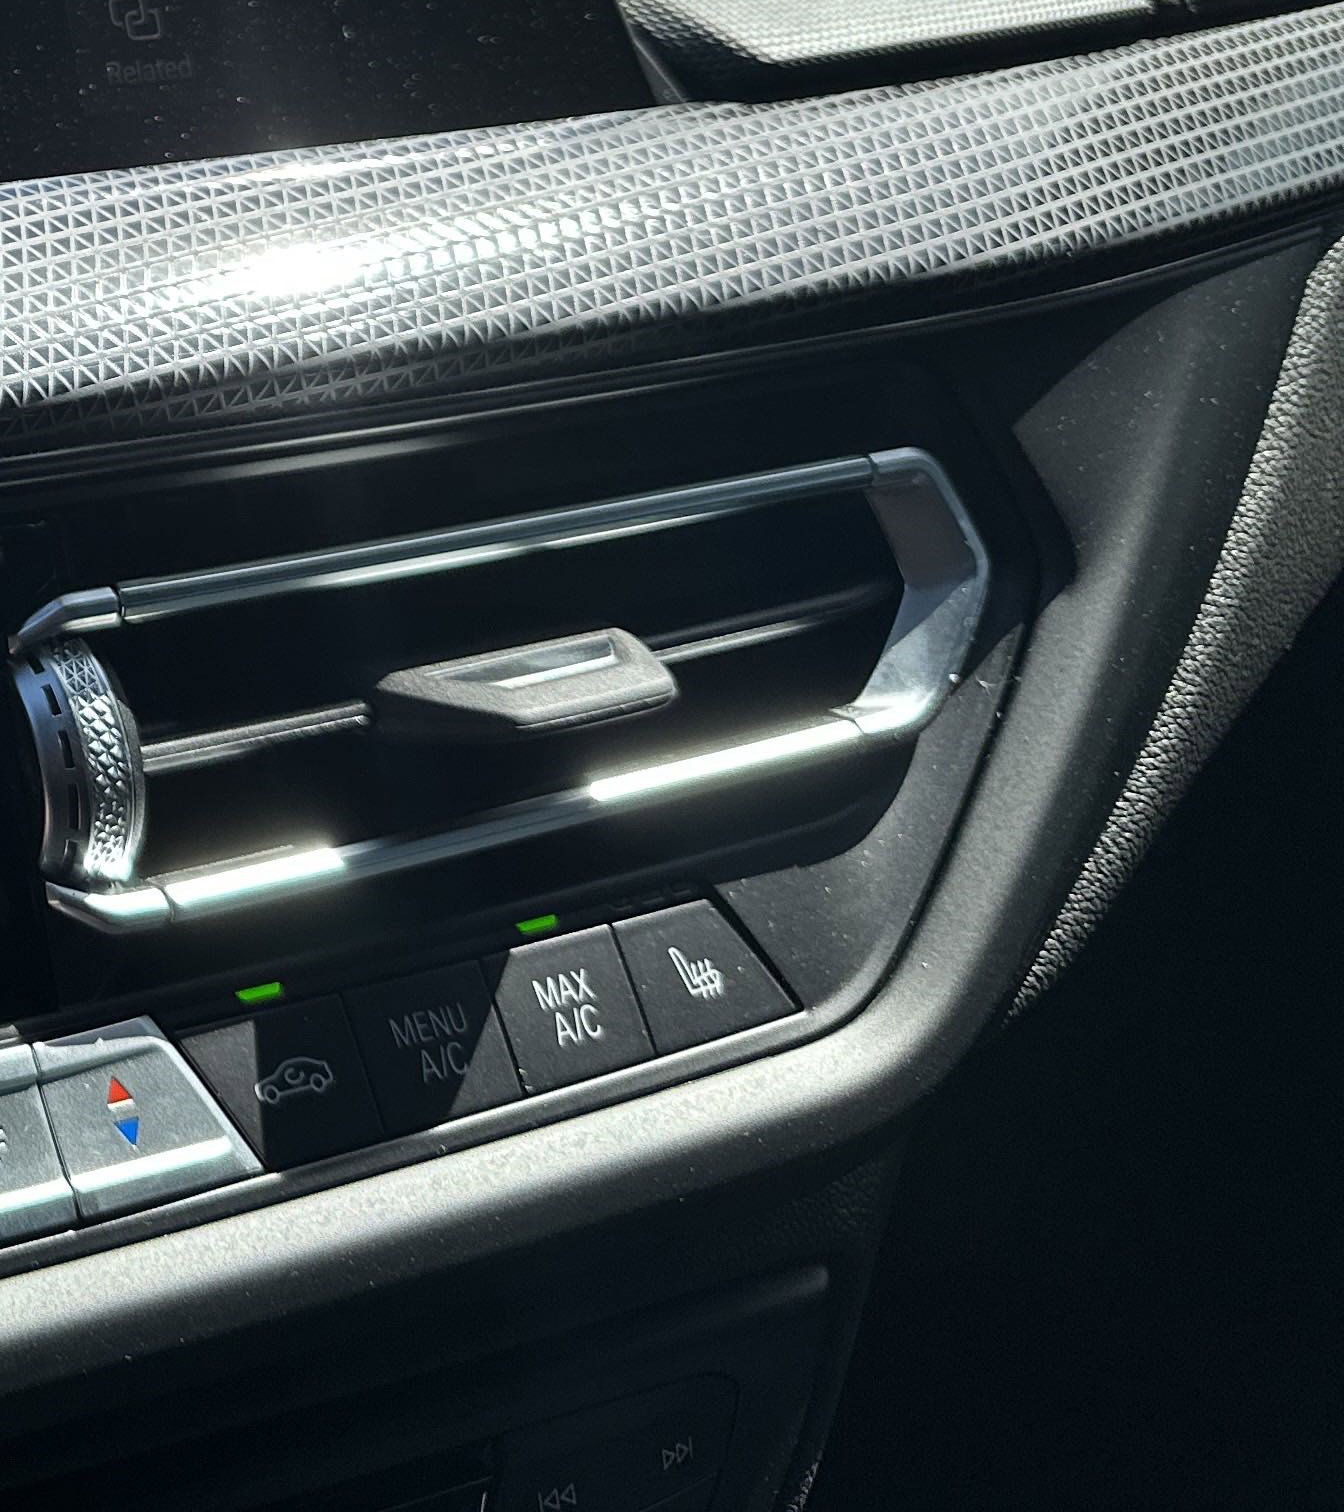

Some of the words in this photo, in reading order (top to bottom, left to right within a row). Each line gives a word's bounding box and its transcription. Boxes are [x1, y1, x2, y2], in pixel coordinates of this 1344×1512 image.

[532, 967, 597, 1013] MAX
[388, 1001, 468, 1049] MENU
[554, 1003, 602, 1048] A/C
[420, 1040, 469, 1084] A/C
